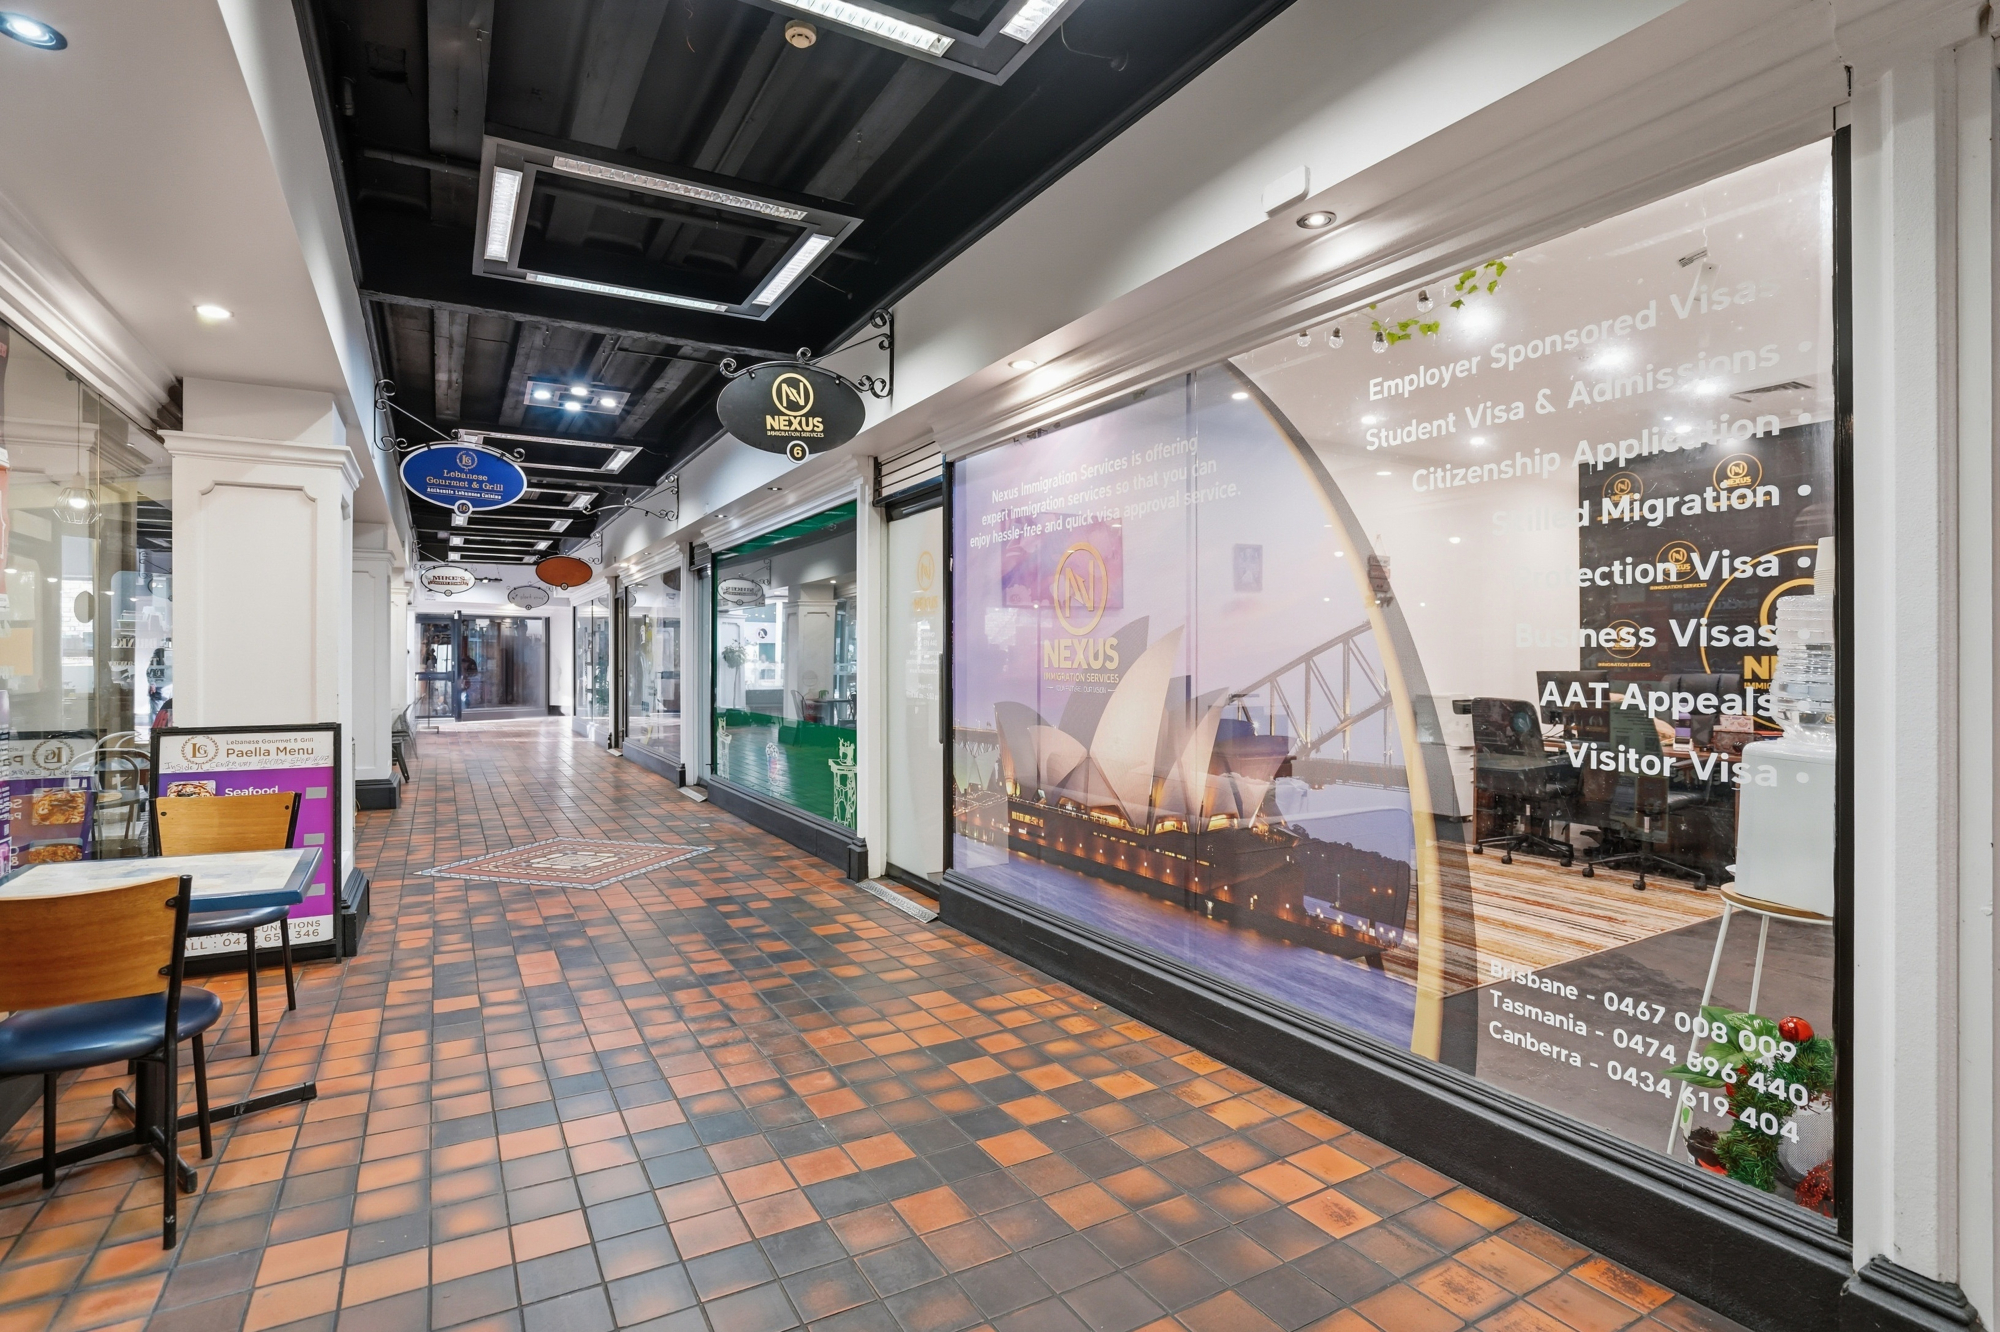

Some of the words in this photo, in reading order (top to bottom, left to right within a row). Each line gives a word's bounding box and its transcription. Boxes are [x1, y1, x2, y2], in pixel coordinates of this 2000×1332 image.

[1368, 355, 1481, 401] Employer
[1489, 299, 1657, 371] Sponsored
[1365, 412, 1457, 452] Student
[1464, 400, 1526, 429] Visa
[1534, 387, 1557, 415] &
[1566, 342, 1781, 410] Admissions
[765, 414, 825, 432] NEXUS
[793, 446, 803, 458] 6
[1411, 447, 1561, 493] Citizenship
[1571, 413, 1780, 472] Application
[426, 476, 469, 488] Gourmet
[471, 481, 480, 489] &
[482, 482, 504, 491] Grill
[443, 469, 488, 481] Lebanese
[991, 486, 1019, 504] Nexus
[1021, 470, 1078, 496] Immigration
[1080, 456, 1128, 480] Services
[1131, 449, 1142, 467] is
[1145, 436, 1198, 463] offering
[426, 487, 454, 495] Authentic
[455, 490, 480, 498] Lebanese
[481, 492, 502, 500] Cuisine
[981, 508, 1009, 527] expert
[1010, 495, 1065, 519] immigration
[1067, 484, 1112, 506] services
[1116, 480, 1130, 495] so
[1132, 470, 1159, 491] that
[1162, 466, 1188, 489] you
[1191, 459, 1217, 477] can
[1491, 500, 1591, 538] Silled
[1601, 480, 1780, 527] Migration
[969, 532, 991, 549] enjoy
[992, 523, 1042, 544] hassle-free
[1044, 515, 1063, 533] and
[1065, 509, 1094, 532] quick
[1096, 506, 1121, 523] visa
[1123, 489, 1180, 521] approval
[1183, 481, 1241, 506] service.
[1689, 549, 1780, 581] Visa
[1682, 582, 1708, 590] SERVICES
[1668, 617, 1779, 649] Visas
[1043, 636, 1120, 670] NEXUS
[1043, 672, 1086, 683] IMMIGRATION
[1086, 672, 1120, 684] SERVICES
[1539, 680, 1611, 710] AAT
[1619, 681, 1778, 721] Appeals
[226, 746, 271, 758] Paella
[276, 745, 314, 756] Menu
[261, 737, 292, 745] Gourmet
[163, 761, 193, 772] Inside
[289, 756, 311, 765] SHOP
[1563, 740, 1677, 778] Visitor
[1689, 750, 1778, 788] Visa
[224, 785, 279, 797] Seafood
[254, 919, 321, 934] FUNTIONS
[294, 928, 320, 939] 346
[1489, 959, 1579, 1000] Brisbane
[1603, 991, 1666, 1025] 0467
[1674, 1011, 1728, 1044] 008
[1738, 1029, 1797, 1063] 009
[1489, 989, 1588, 1037] Tasmania
[1612, 1028, 1677, 1065] 0474
[1686, 1050, 1737, 1084] 596
[1747, 1071, 1809, 1107] 440
[1488, 1020, 1582, 1068] Canberra
[1606, 1060, 1673, 1099] 0434
[1681, 1086, 1730, 1118] 619
[1739, 1106, 1800, 1144] 404
